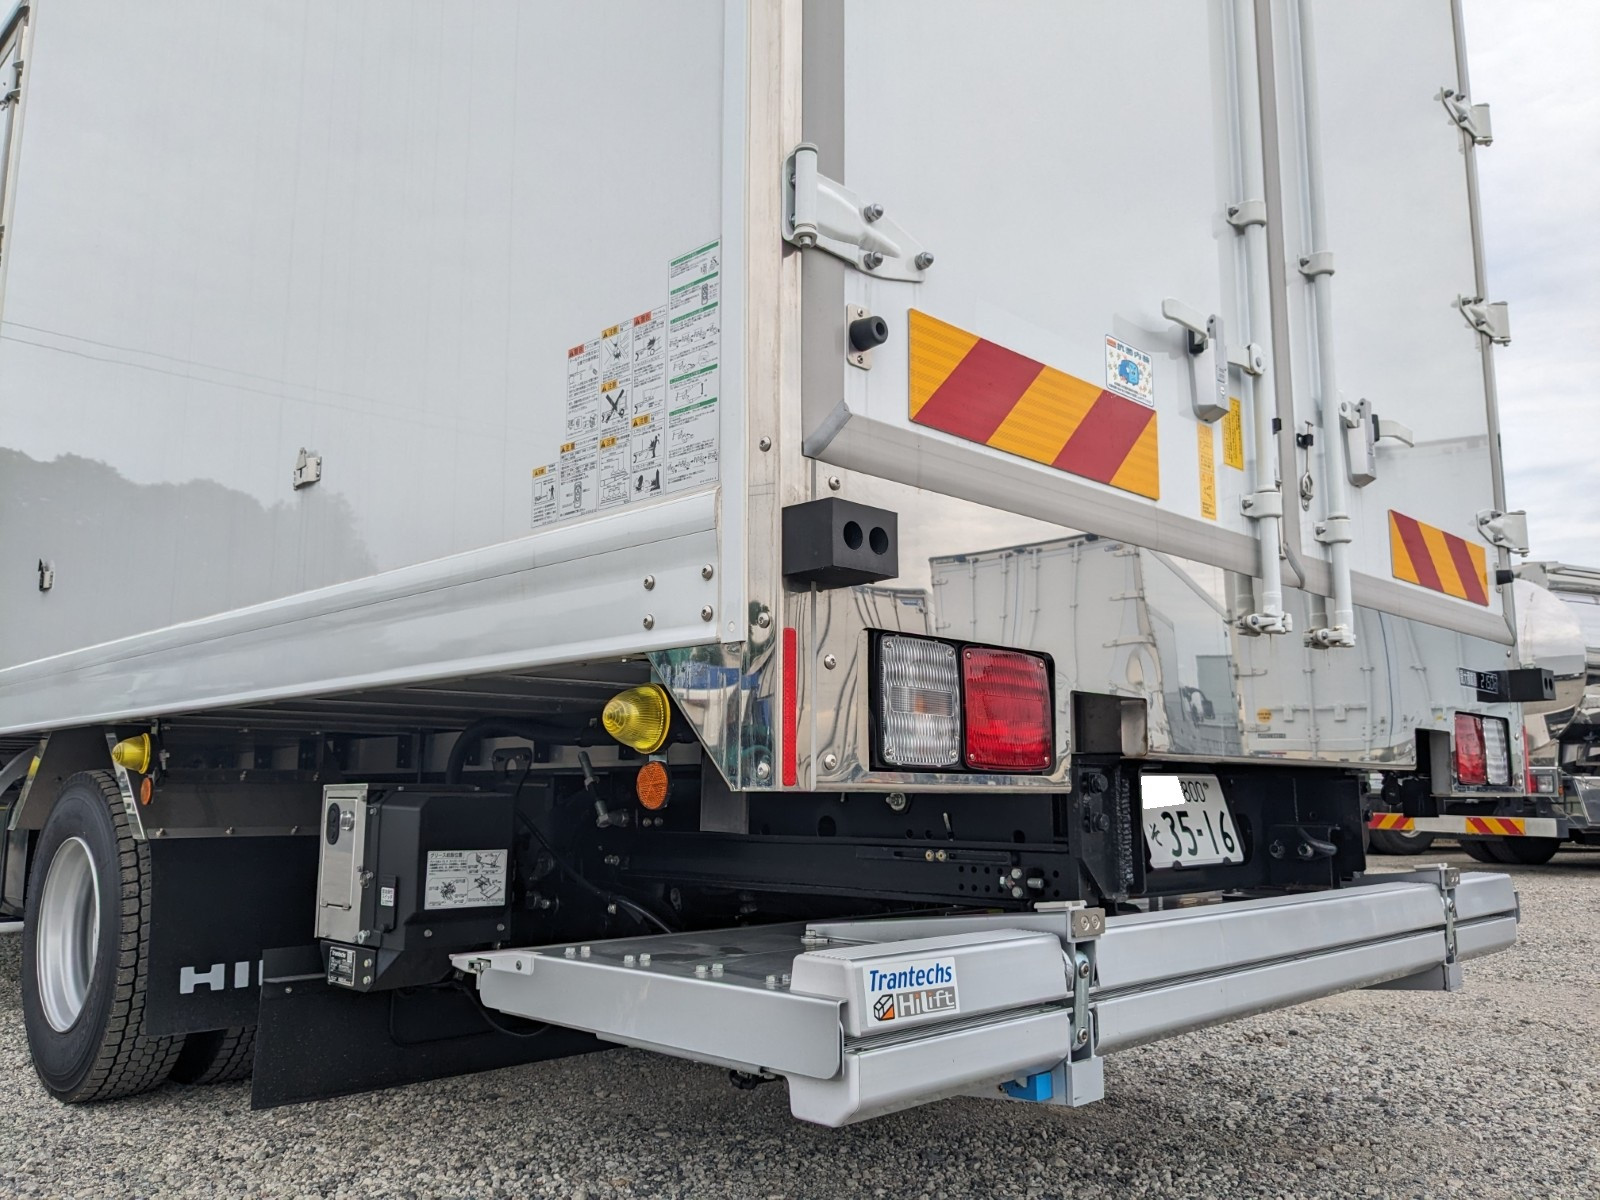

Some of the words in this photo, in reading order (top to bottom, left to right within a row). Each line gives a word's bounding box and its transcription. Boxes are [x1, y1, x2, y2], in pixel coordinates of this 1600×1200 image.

[1181, 781, 1205, 802] 800
[1161, 810, 1235, 857] 35-16
[180, 959, 263, 995] HI
[869, 963, 952, 992] Trantechs
